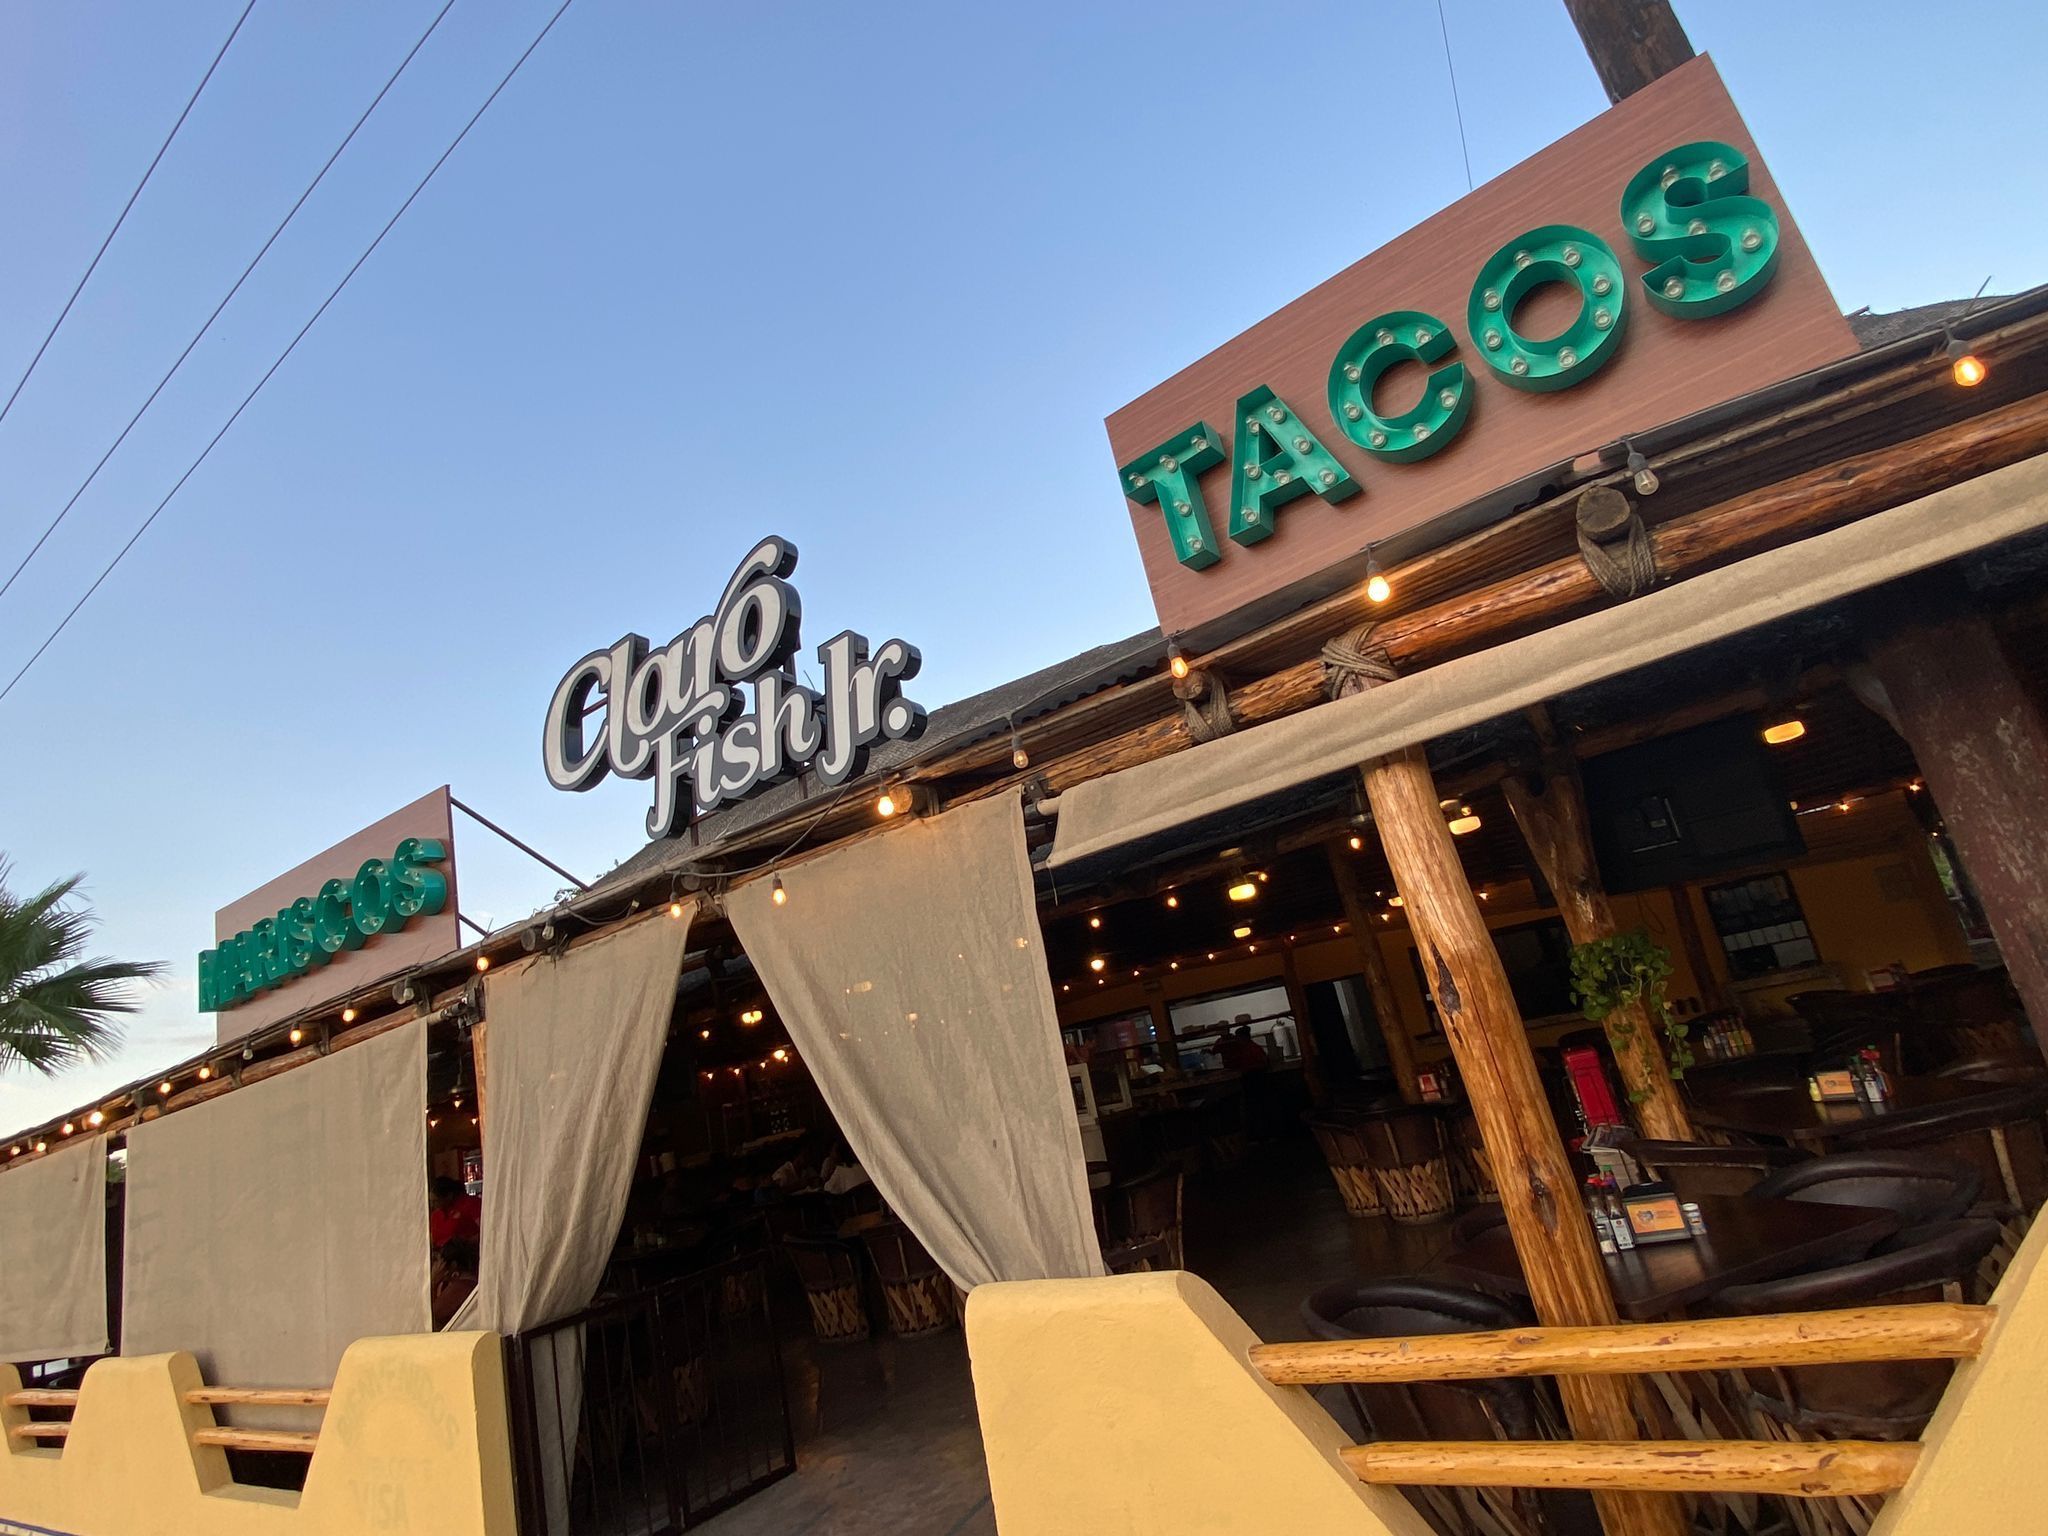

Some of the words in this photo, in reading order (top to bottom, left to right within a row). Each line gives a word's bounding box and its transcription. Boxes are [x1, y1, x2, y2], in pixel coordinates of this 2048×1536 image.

[1118, 140, 1780, 571] TACOS
[646, 670, 822, 840] Fish
[815, 629, 927, 787] Jr.
[198, 837, 447, 1013] MARISCOS
